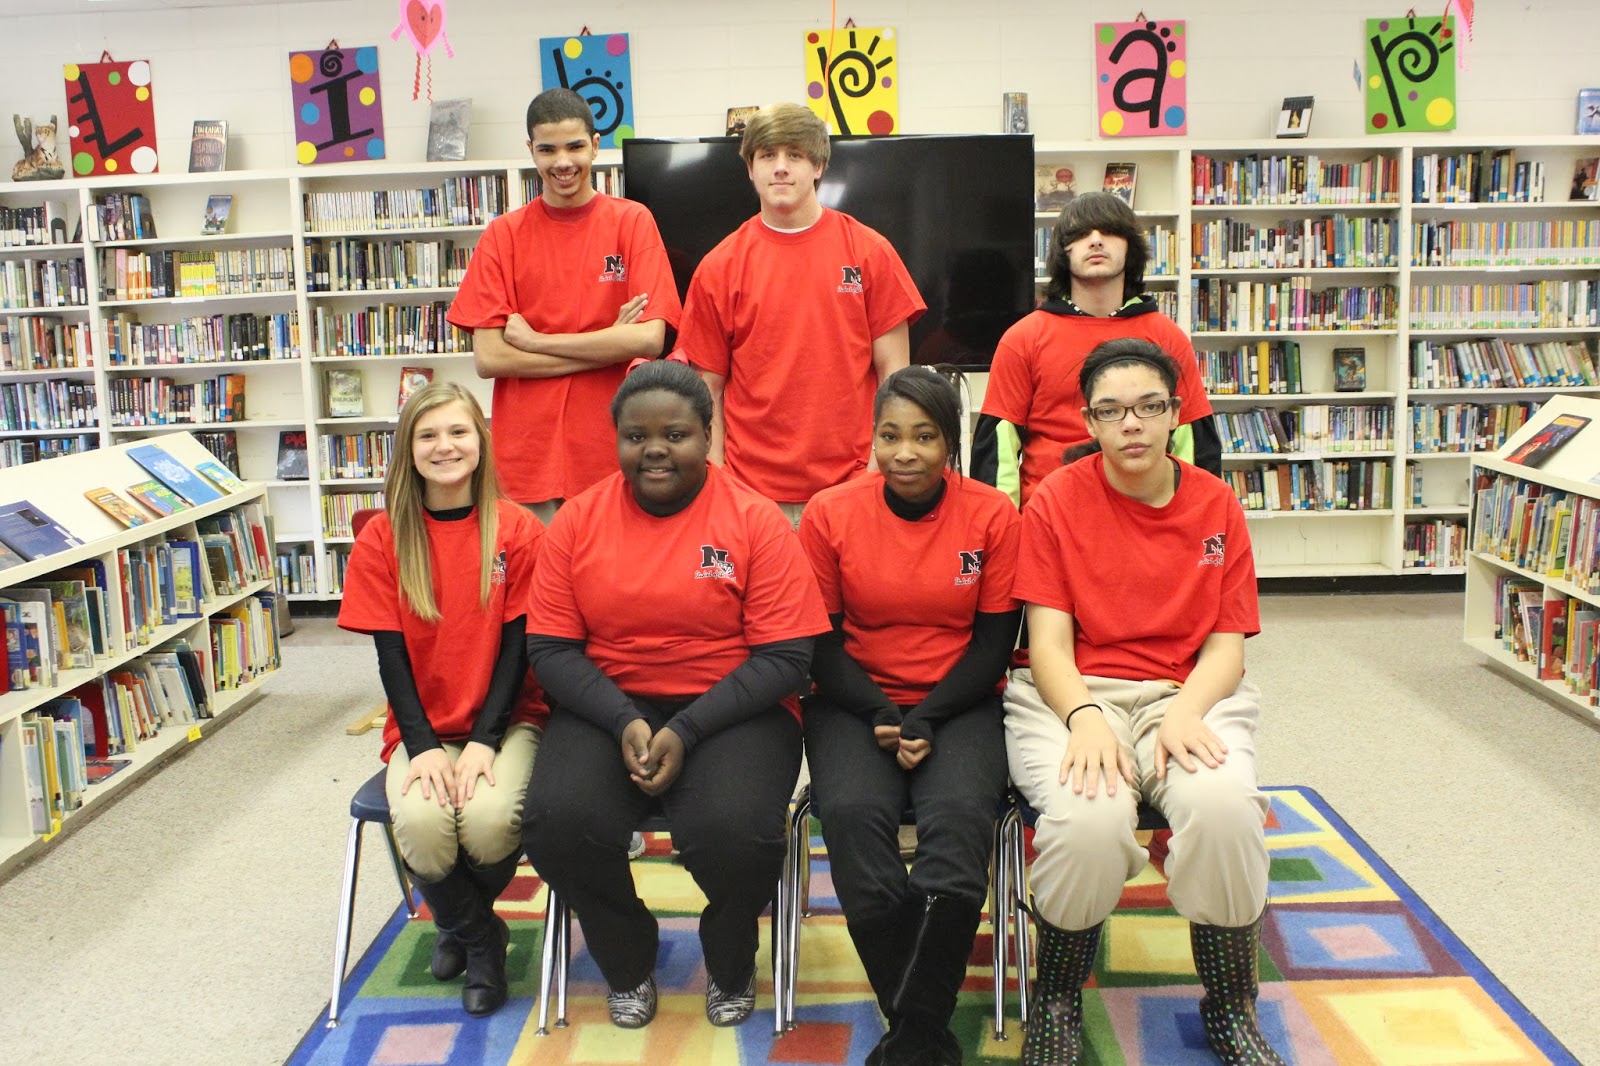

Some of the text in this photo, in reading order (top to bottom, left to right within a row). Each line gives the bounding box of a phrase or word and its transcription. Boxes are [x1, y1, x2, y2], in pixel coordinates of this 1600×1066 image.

[70, 71, 143, 159] L
[1109, 22, 1176, 128] a
[701, 545, 728, 568] N
